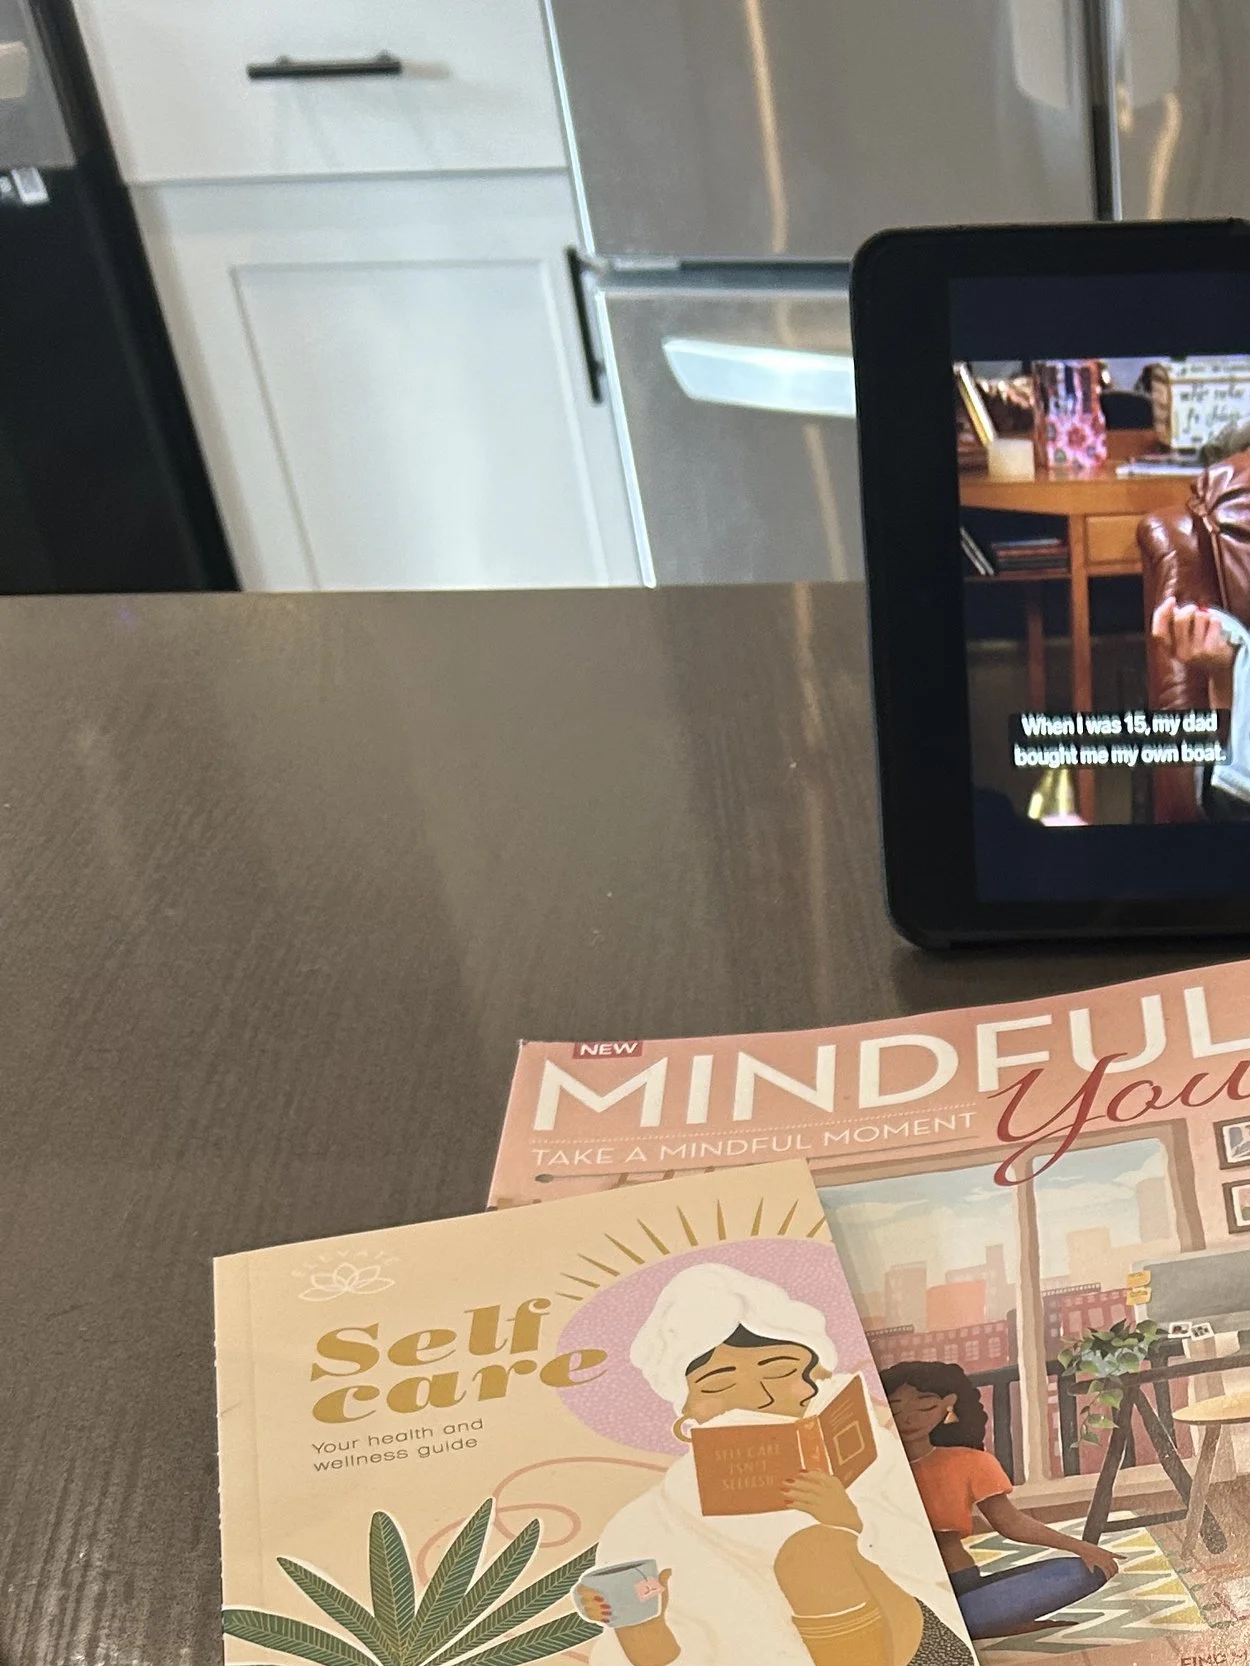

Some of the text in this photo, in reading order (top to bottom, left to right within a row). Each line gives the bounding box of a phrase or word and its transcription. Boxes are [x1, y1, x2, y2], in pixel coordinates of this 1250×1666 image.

[1021, 709, 1218, 736] When I was 15, my dad
[1014, 740, 1227, 768] bought me my own boat.
[579, 1042, 639, 1057] NEW
[532, 1111, 977, 1167] TAKE A MINDFUL MOMENT
[310, 1298, 552, 1381] Self
[311, 1348, 608, 1424] care
[311, 1418, 484, 1455] Your health and
[312, 1436, 478, 1472] wellness guide
